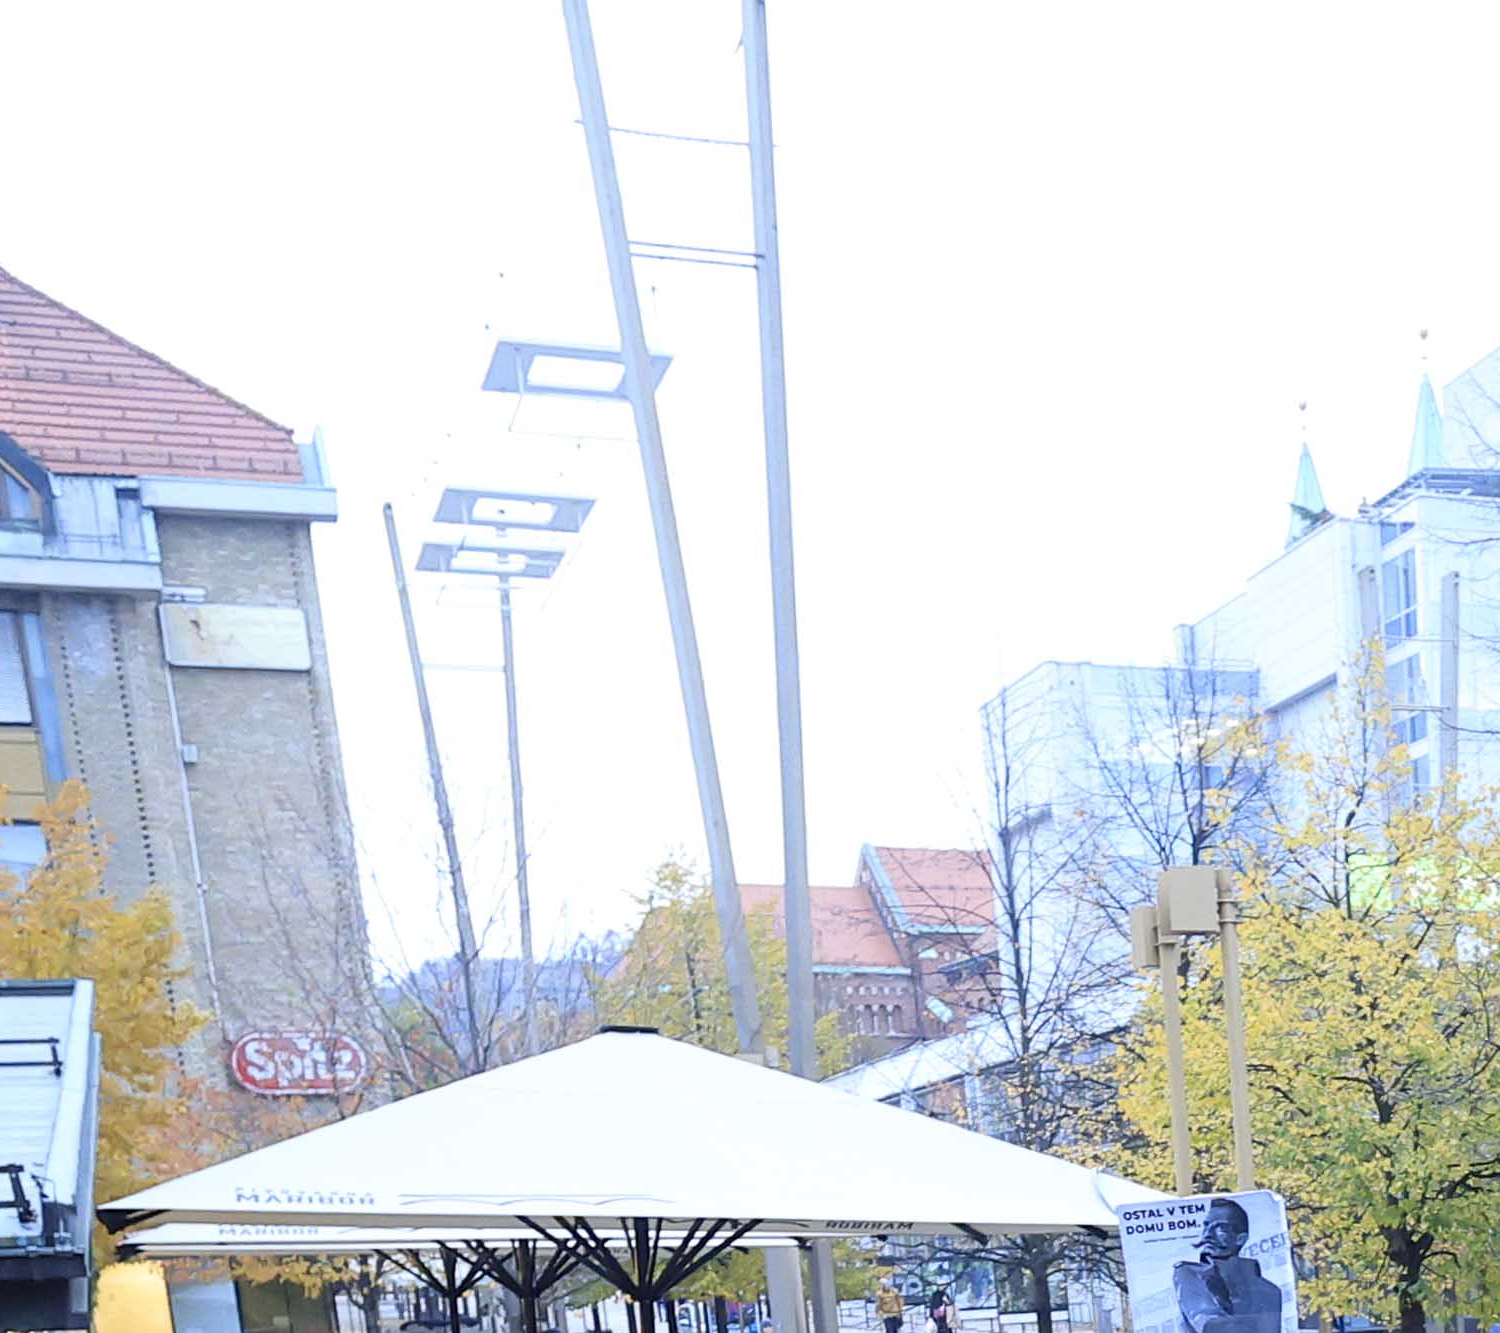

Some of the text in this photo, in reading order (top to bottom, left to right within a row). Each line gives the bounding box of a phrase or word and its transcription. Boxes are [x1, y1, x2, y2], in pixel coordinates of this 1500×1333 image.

[244, 1037, 356, 1087] Spitz
[1123, 1203, 1206, 1221] OSTAL V TEM
[1125, 1218, 1202, 1235] DOMU BOM.
